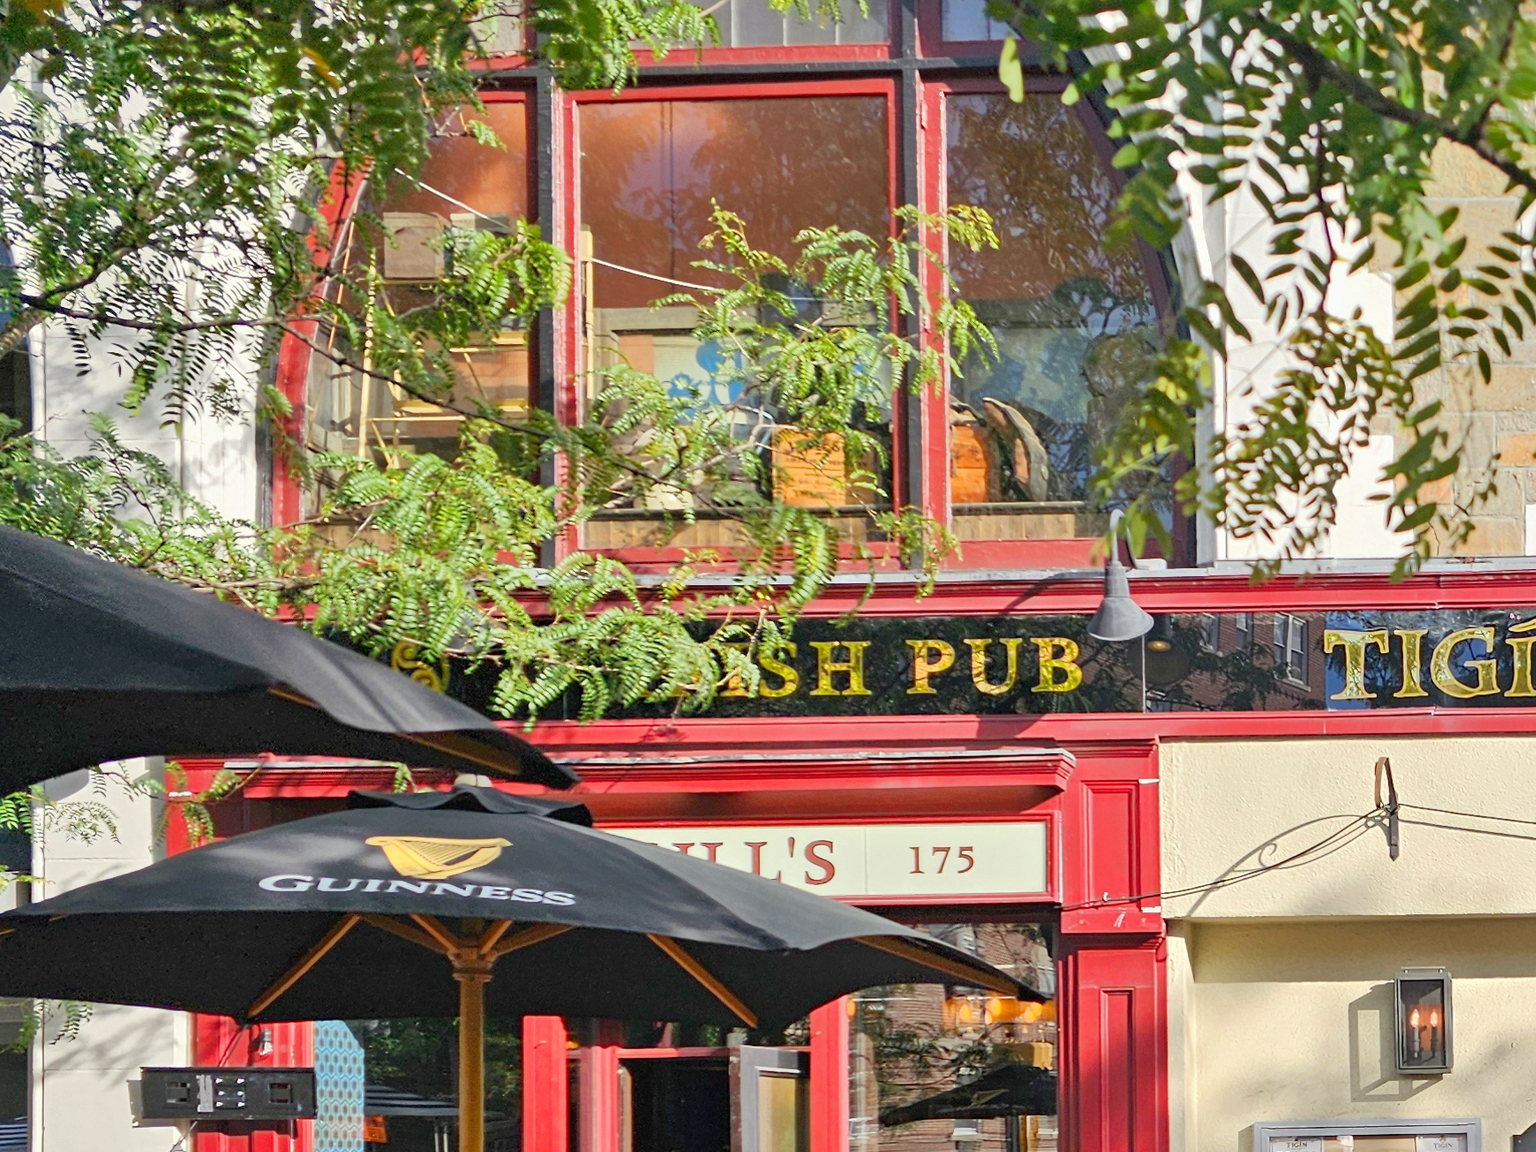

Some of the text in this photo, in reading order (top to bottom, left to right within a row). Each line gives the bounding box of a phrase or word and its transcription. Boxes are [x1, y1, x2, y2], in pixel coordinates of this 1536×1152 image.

[904, 637, 1084, 697] PUB
[909, 845, 976, 876] 175
[258, 874, 577, 907] GUINNESS
